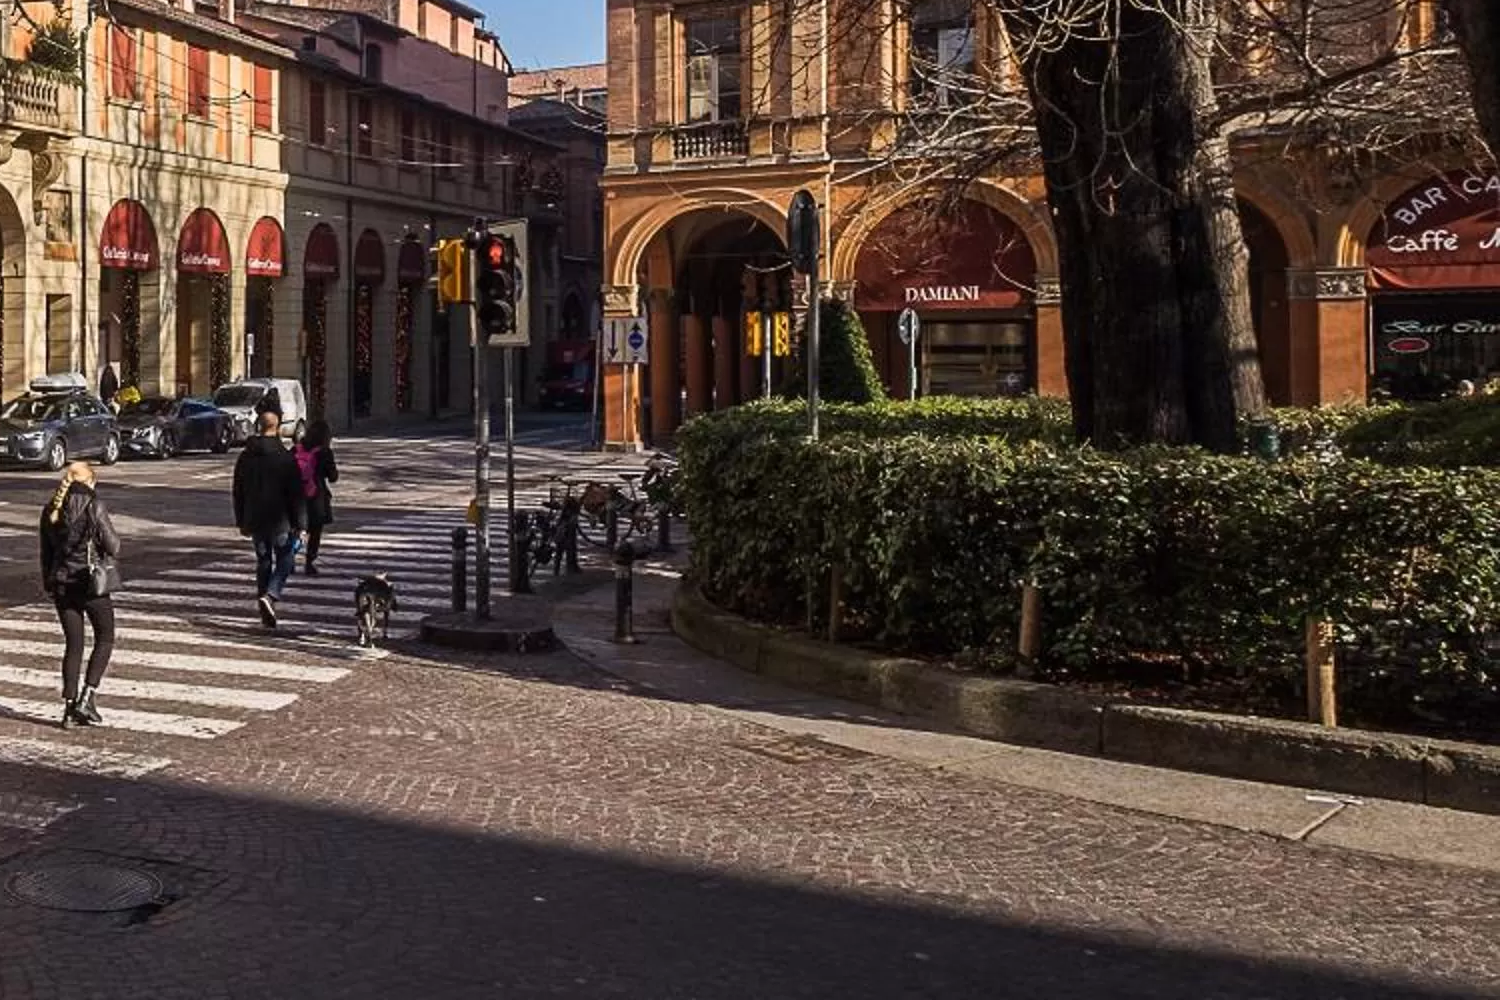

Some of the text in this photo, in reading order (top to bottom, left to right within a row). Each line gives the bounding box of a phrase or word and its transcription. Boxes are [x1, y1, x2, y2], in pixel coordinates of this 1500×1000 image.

[1394, 186, 1448, 225] BAR
[1387, 229, 1459, 252] Caffè
[905, 285, 980, 302] DAMIANI
